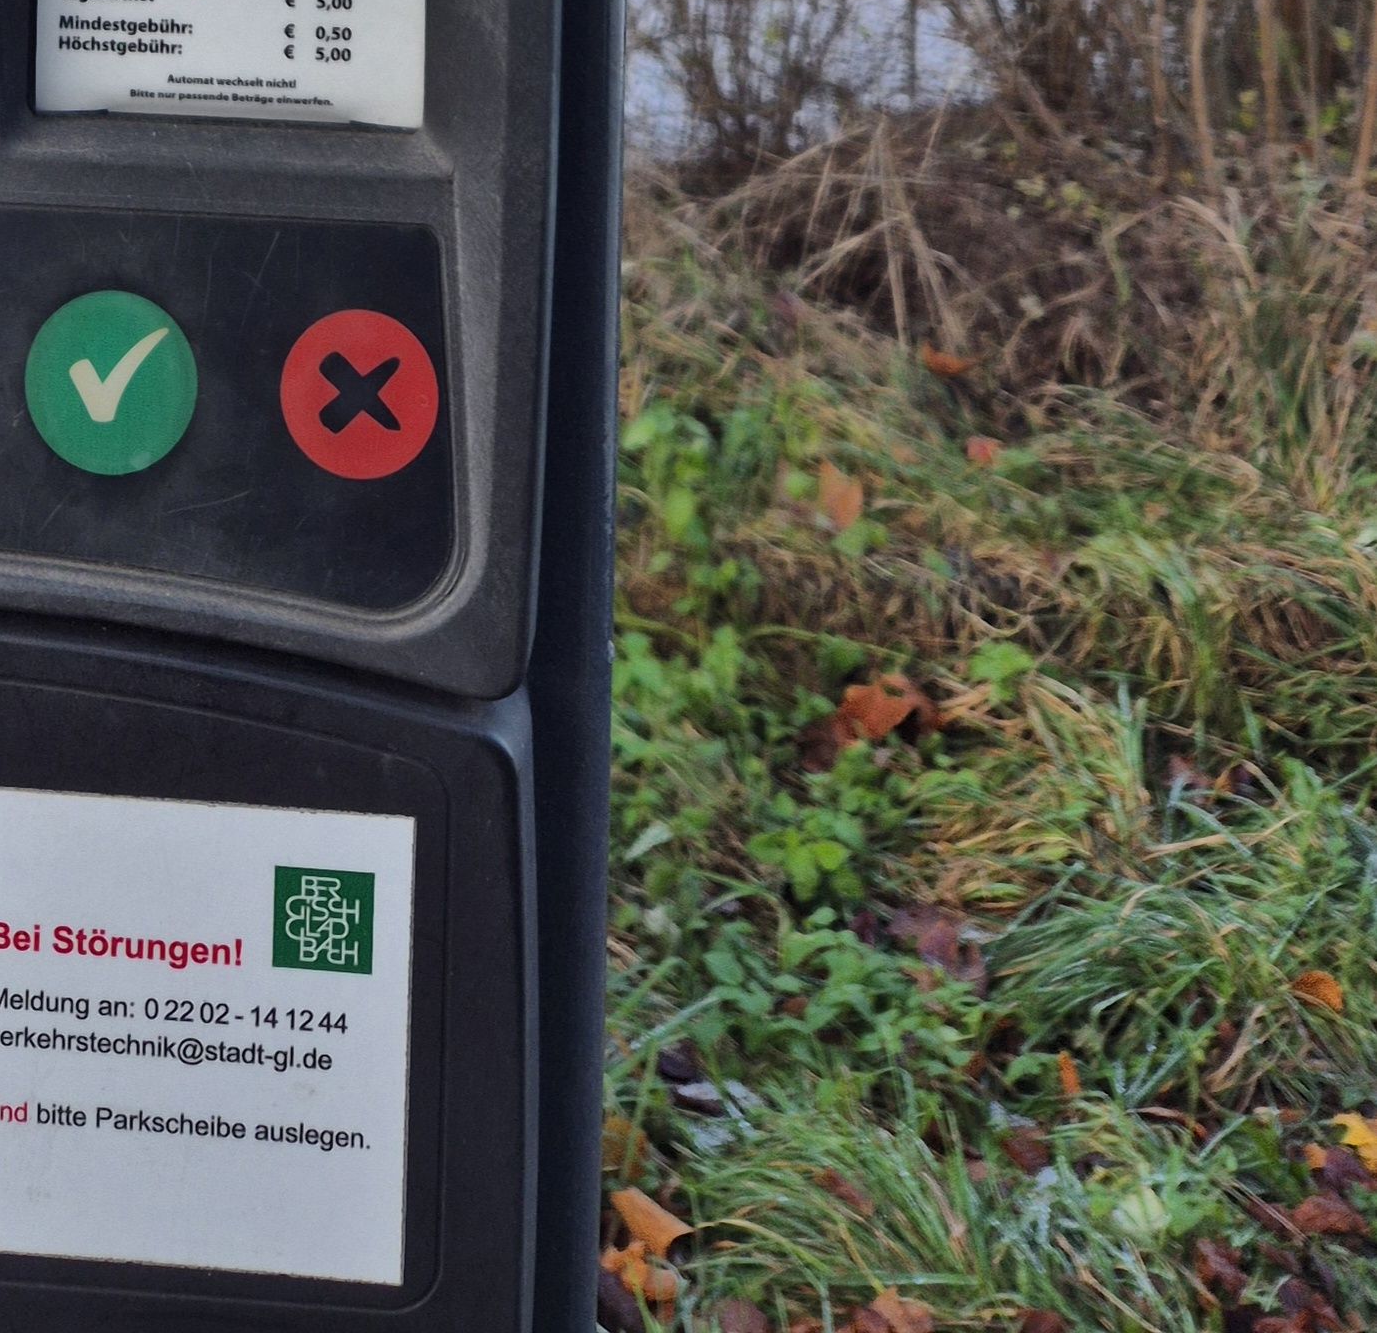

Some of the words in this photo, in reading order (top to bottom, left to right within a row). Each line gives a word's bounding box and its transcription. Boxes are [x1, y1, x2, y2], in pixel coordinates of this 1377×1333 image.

[58, 15, 193, 35] Mindestgebühr:
[283, 23, 295, 38] €
[315, 26, 352, 42] 0,50
[58, 36, 183, 56] Höchstgebühr:
[283, 44, 295, 59] €
[315, 47, 351, 63] 5,00
[167, 74, 214, 85] Automat
[216, 77, 264, 88] wechselt
[130, 89, 155, 98] Bitte
[158, 91, 175, 99] nur
[178, 92, 229, 101] passende
[232, 93, 273, 104] Beträge
[52, 923, 244, 969] Störungen!
[98, 999, 136, 1019] an:
[36, 1103, 87, 1127] bitte
[95, 1107, 246, 1139] Parkscheibe
[254, 1120, 371, 1152] auslegen.
